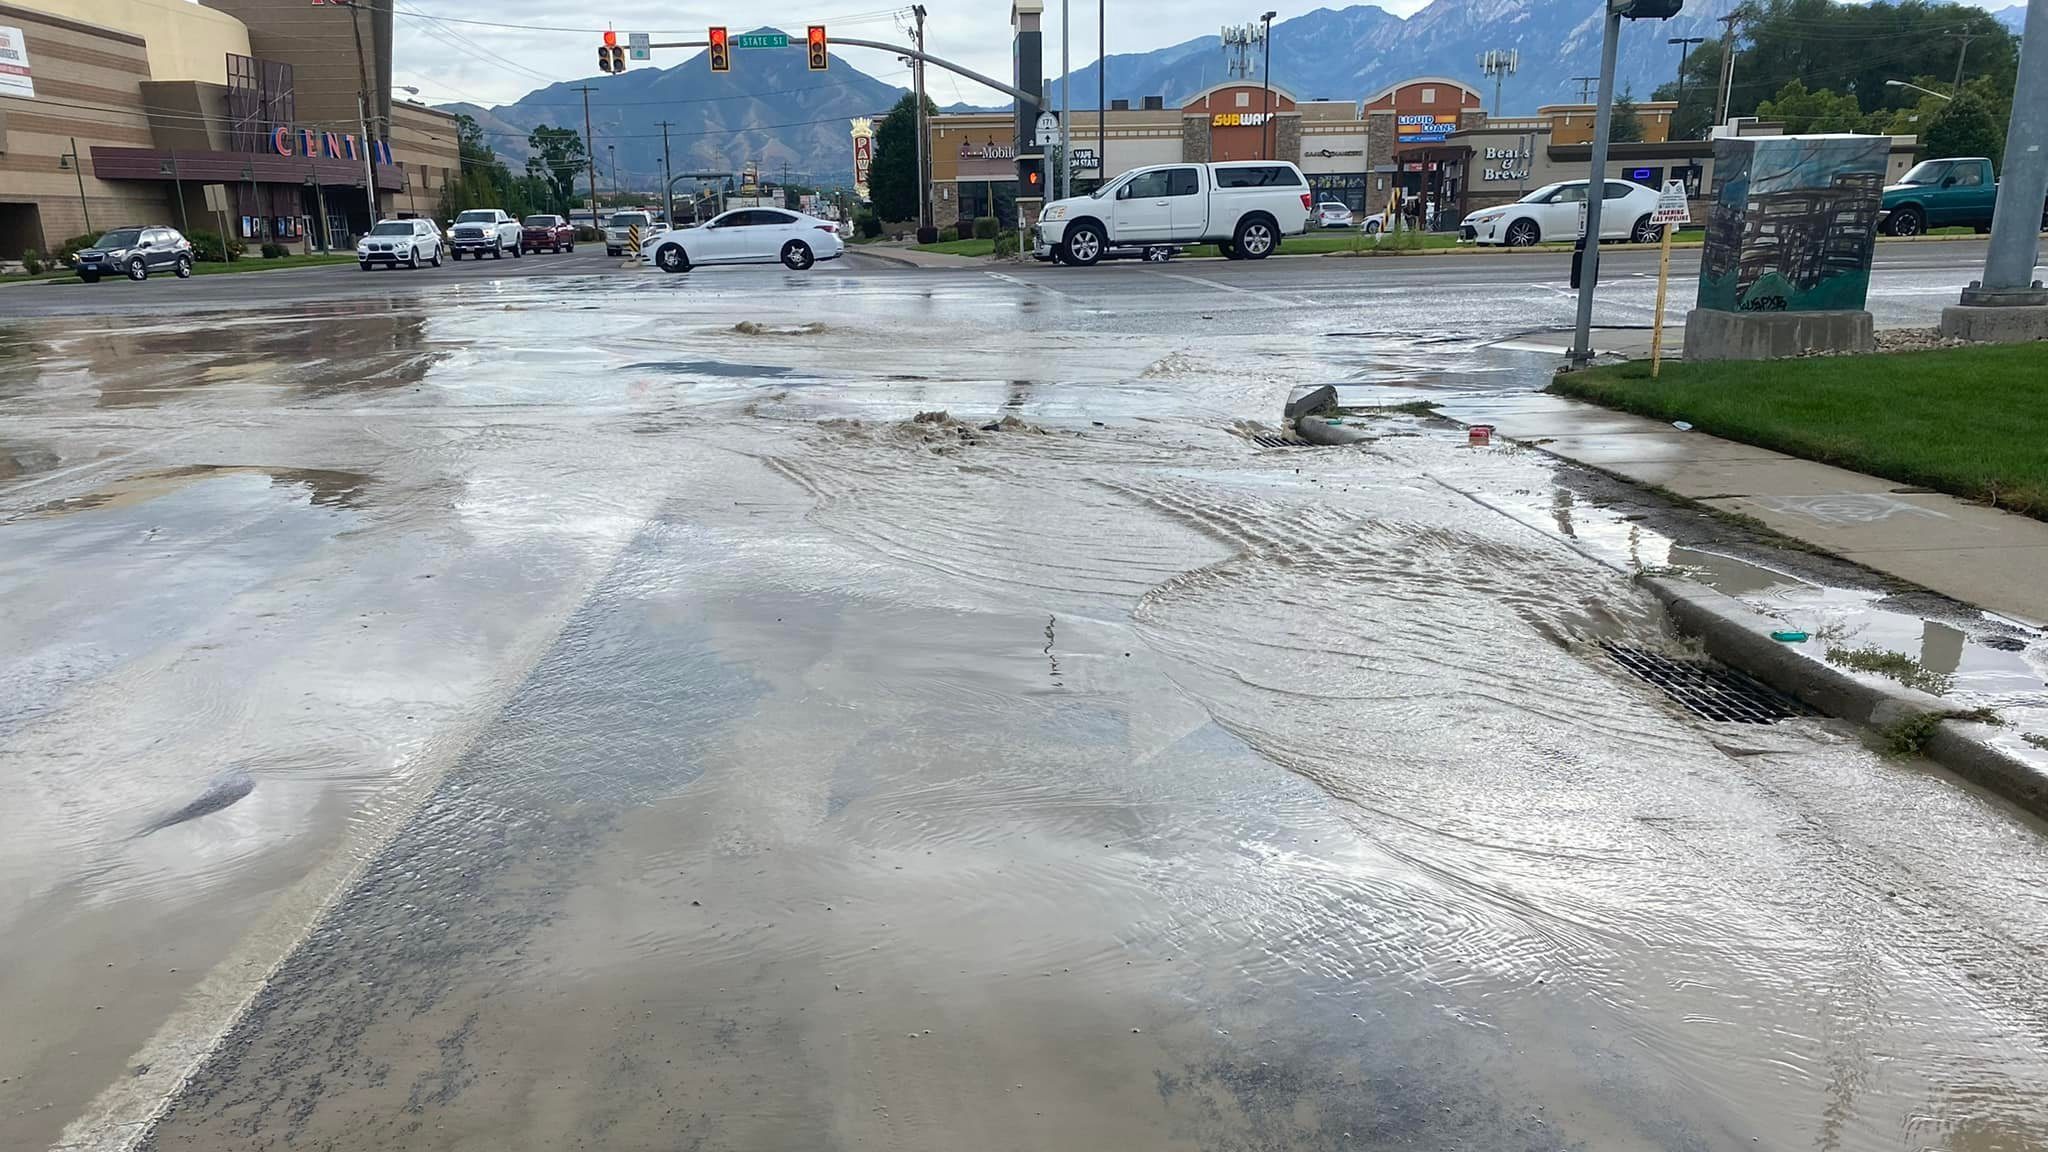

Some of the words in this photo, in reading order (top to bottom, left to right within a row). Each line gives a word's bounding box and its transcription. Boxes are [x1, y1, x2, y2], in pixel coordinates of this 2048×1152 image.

[743, 36, 768, 46] STATE
[773, 36, 783, 45] ST
[1042, 118, 1053, 126] 171
[1212, 112, 1274, 126] SUBWAY
[1398, 115, 1434, 124] LIQUID
[1421, 124, 1456, 133] LOANS
[1074, 150, 1092, 159] VAPE
[1080, 158, 1098, 167] STATE
[1502, 159, 1513, 169] &
